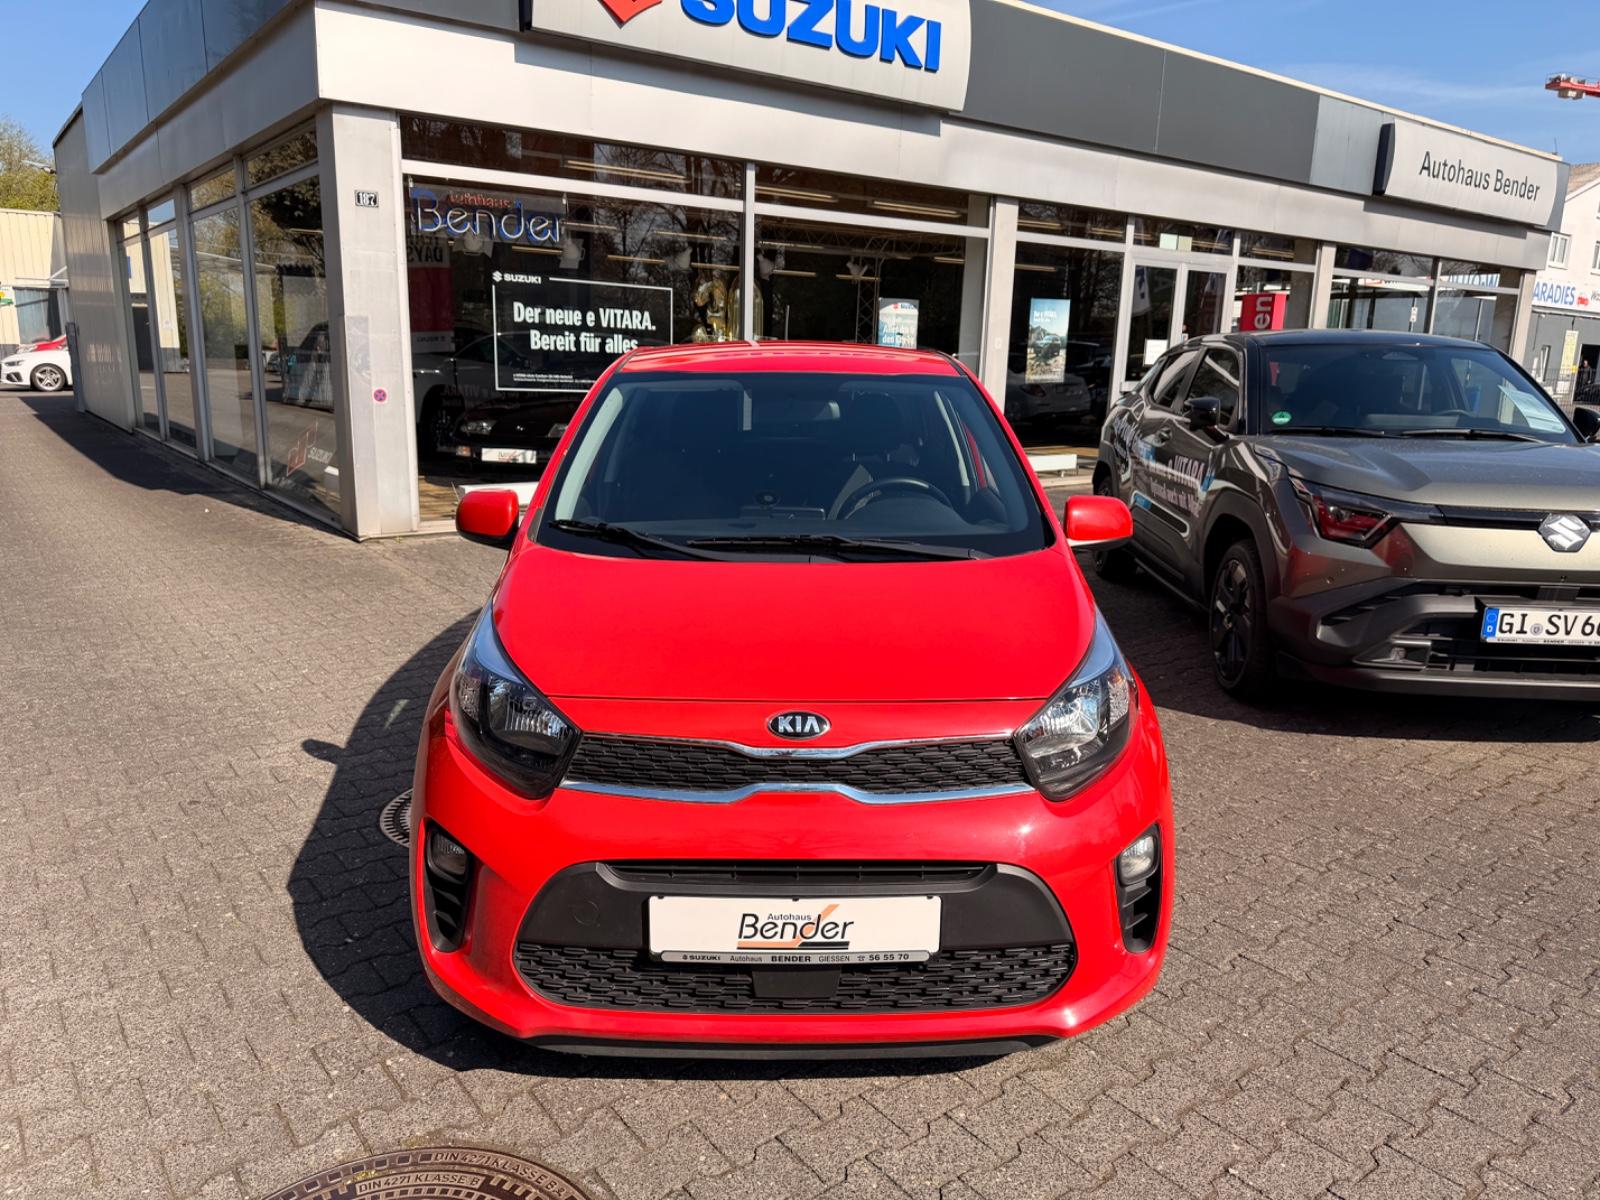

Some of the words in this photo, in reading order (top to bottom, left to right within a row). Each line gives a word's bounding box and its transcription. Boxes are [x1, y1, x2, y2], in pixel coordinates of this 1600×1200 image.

[1419, 151, 1490, 190] Autohaus
[1494, 168, 1540, 201] Bender
[410, 187, 561, 243] Bender
[503, 272, 542, 284] SUZUKI
[513, 301, 541, 323] Der
[545, 307, 583, 326] neue
[586, 310, 596, 326] e
[599, 307, 656, 331] VITARA.
[530, 329, 576, 351] Bereit
[579, 332, 602, 353] für
[1498, 613, 1529, 634] GI
[1545, 614, 1578, 636] SV
[1581, 615, 1600, 637] 6
[778, 715, 820, 733] KIA
[738, 913, 854, 939] Bender
[767, 913, 812, 921] Autohaus
[868, 953, 880, 961] 56
[883, 953, 895, 961] 55
[898, 953, 909, 961] 70
[434, 1152, 459, 1161] DIN
[460, 1155, 489, 1165] 4271
[491, 1158, 548, 1185] KLASSE
[359, 1180, 381, 1193] DIN
[384, 1175, 411, 1186] 4271
[415, 1173, 466, 1185] KLASSE
[470, 1177, 480, 1186] B
